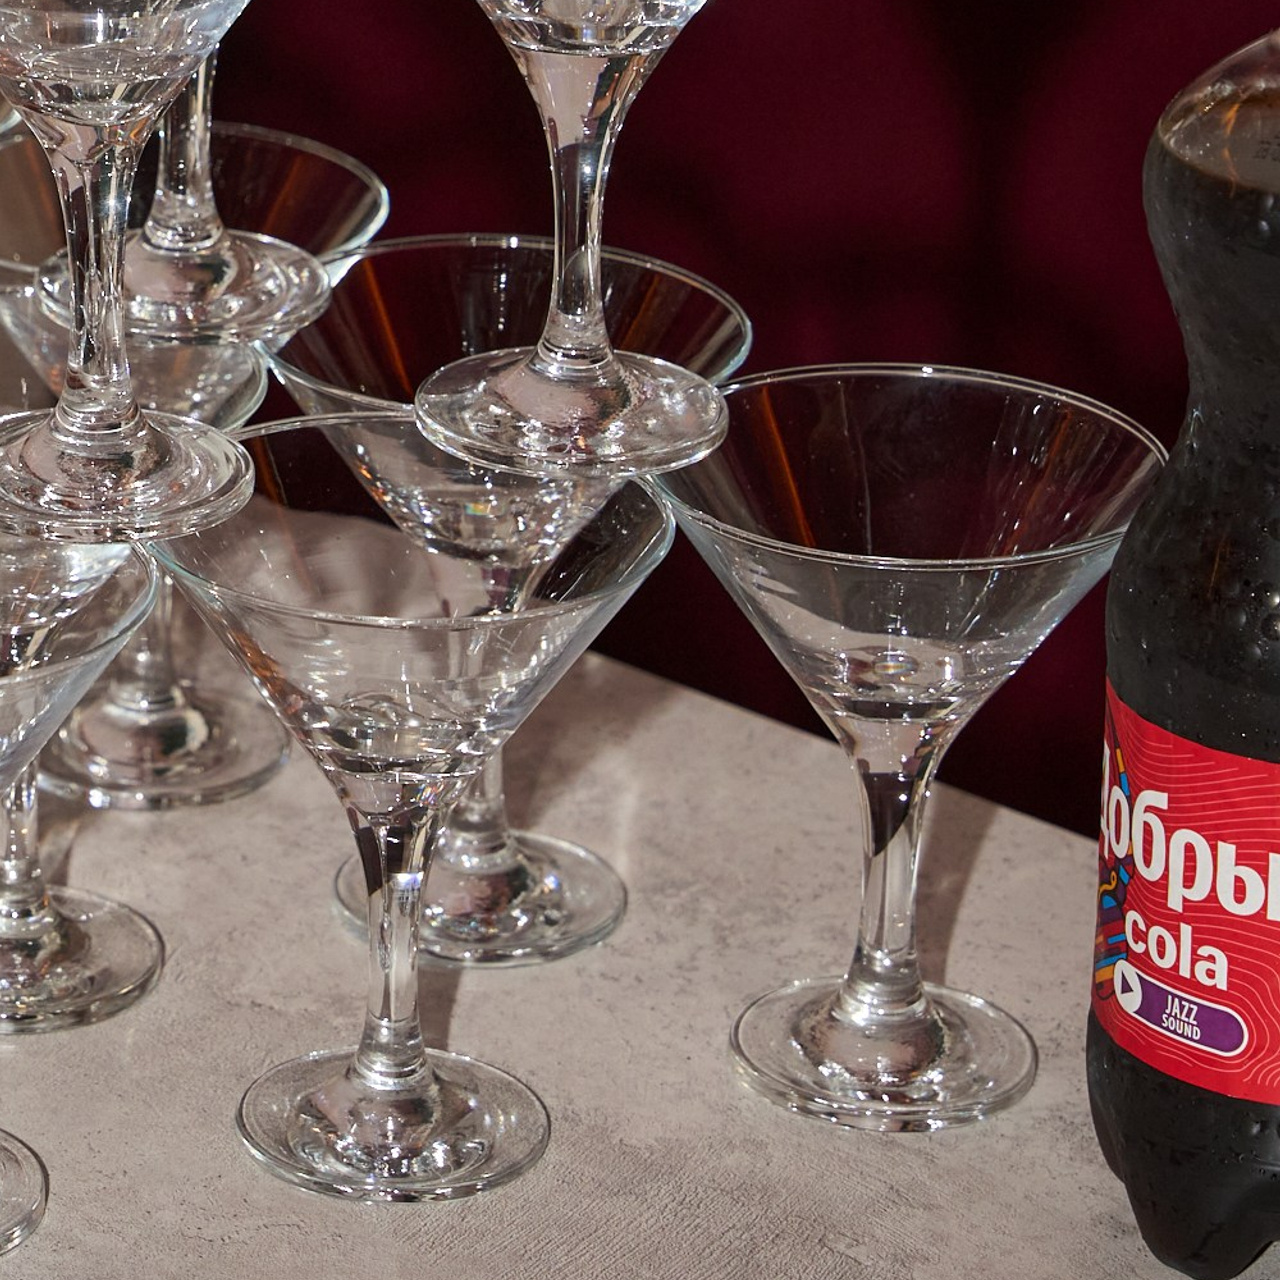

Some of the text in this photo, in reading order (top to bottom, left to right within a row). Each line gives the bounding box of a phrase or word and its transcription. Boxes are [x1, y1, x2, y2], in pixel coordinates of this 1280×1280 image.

[1125, 910, 1228, 991] cola
[1165, 994, 1198, 1026] JAZZ
[1162, 1013, 1201, 1041] SOUND
